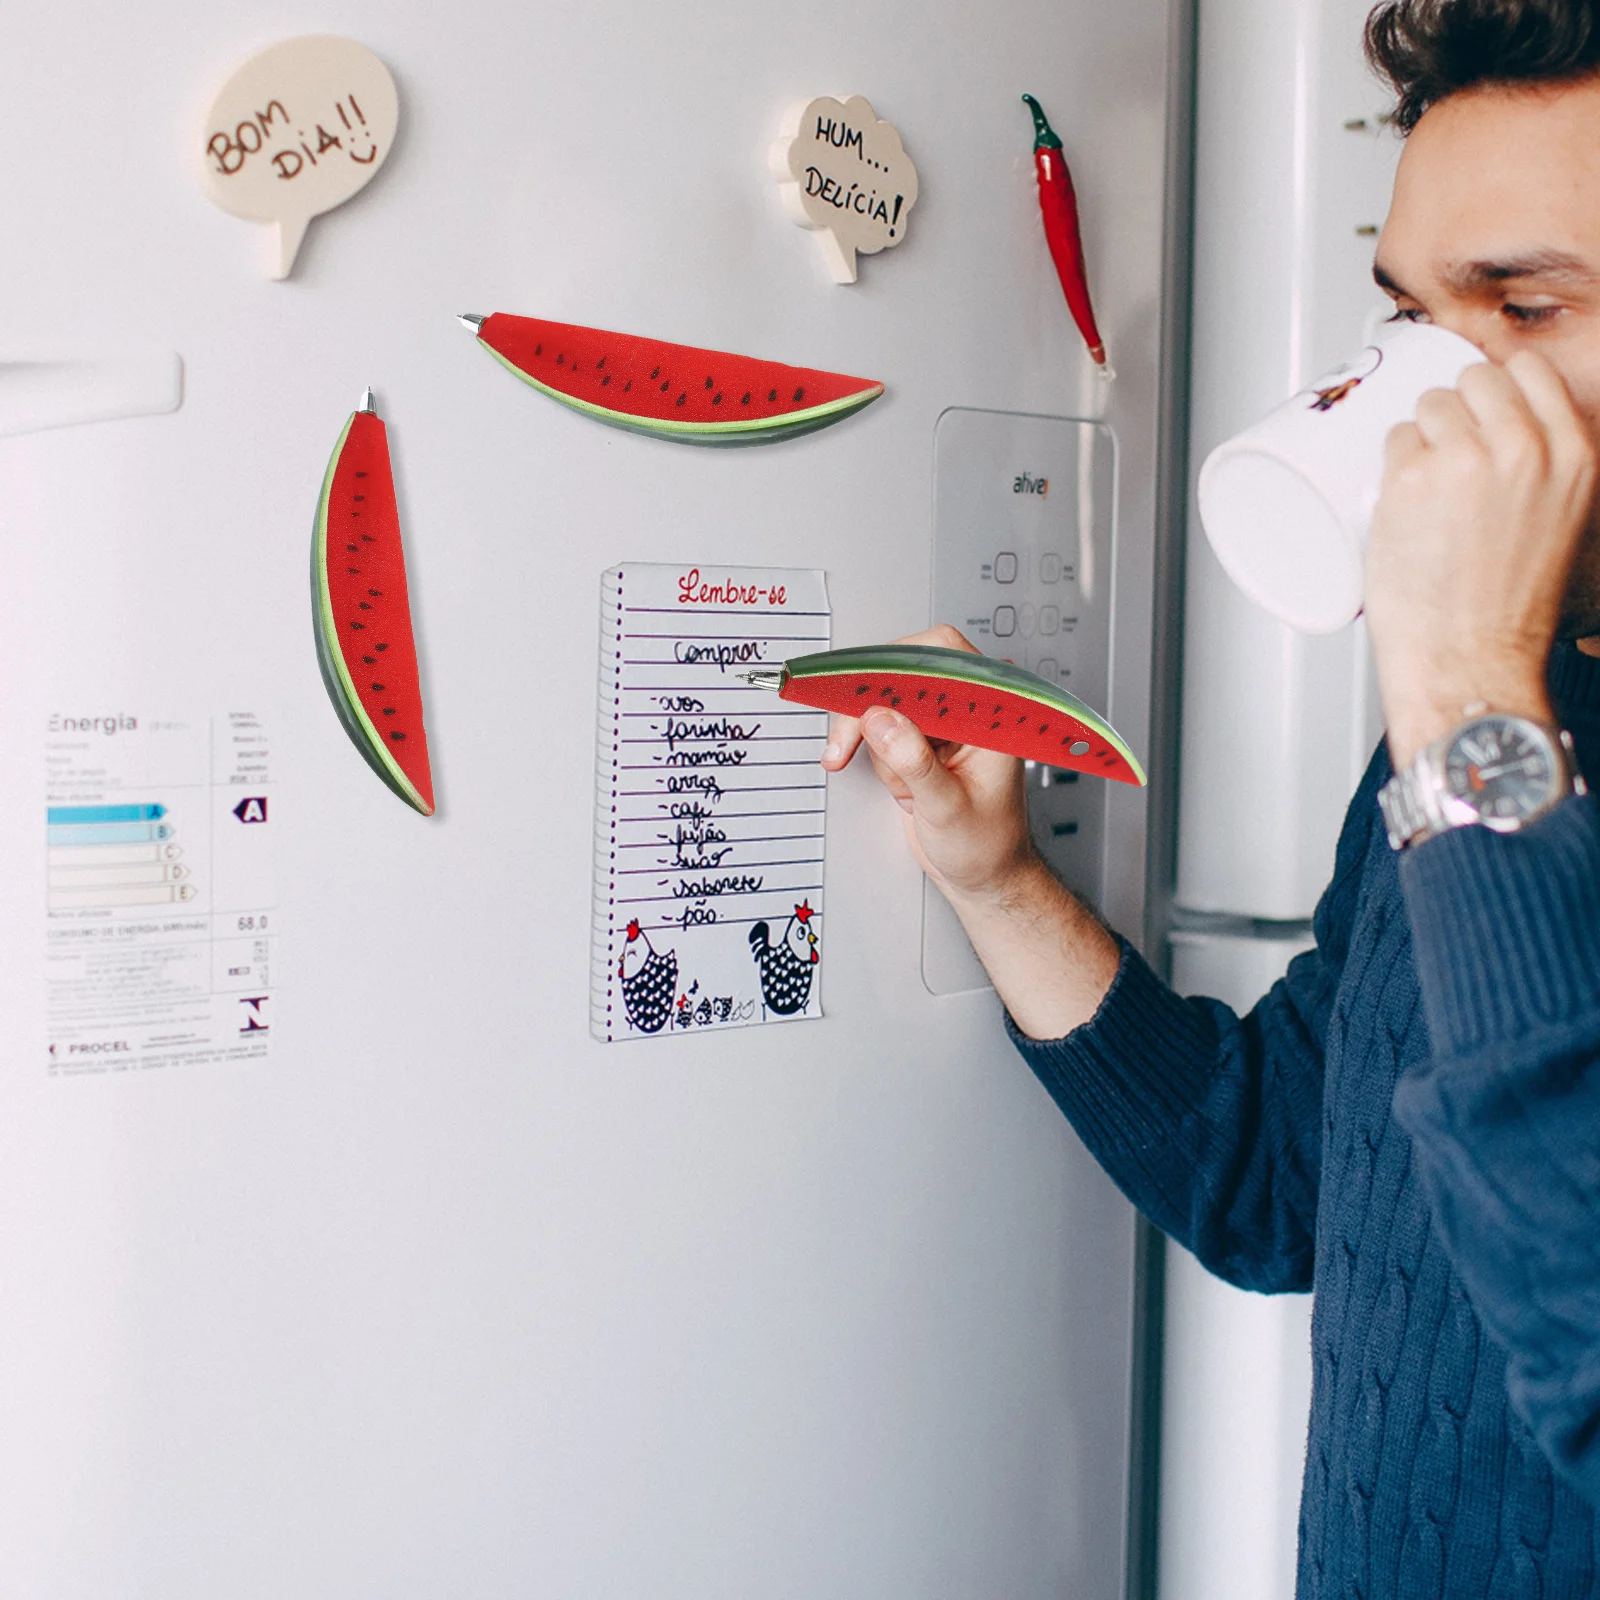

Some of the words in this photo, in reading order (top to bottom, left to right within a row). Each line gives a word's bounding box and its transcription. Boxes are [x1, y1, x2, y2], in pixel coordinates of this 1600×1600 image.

[207, 100, 290, 176] BOM
[815, 115, 889, 173] HUM...
[678, 568, 788, 606] Lembre-se
[48, 712, 138, 736] Energia
[242, 799, 265, 822] A
[69, 1040, 132, 1055] PROCEL
